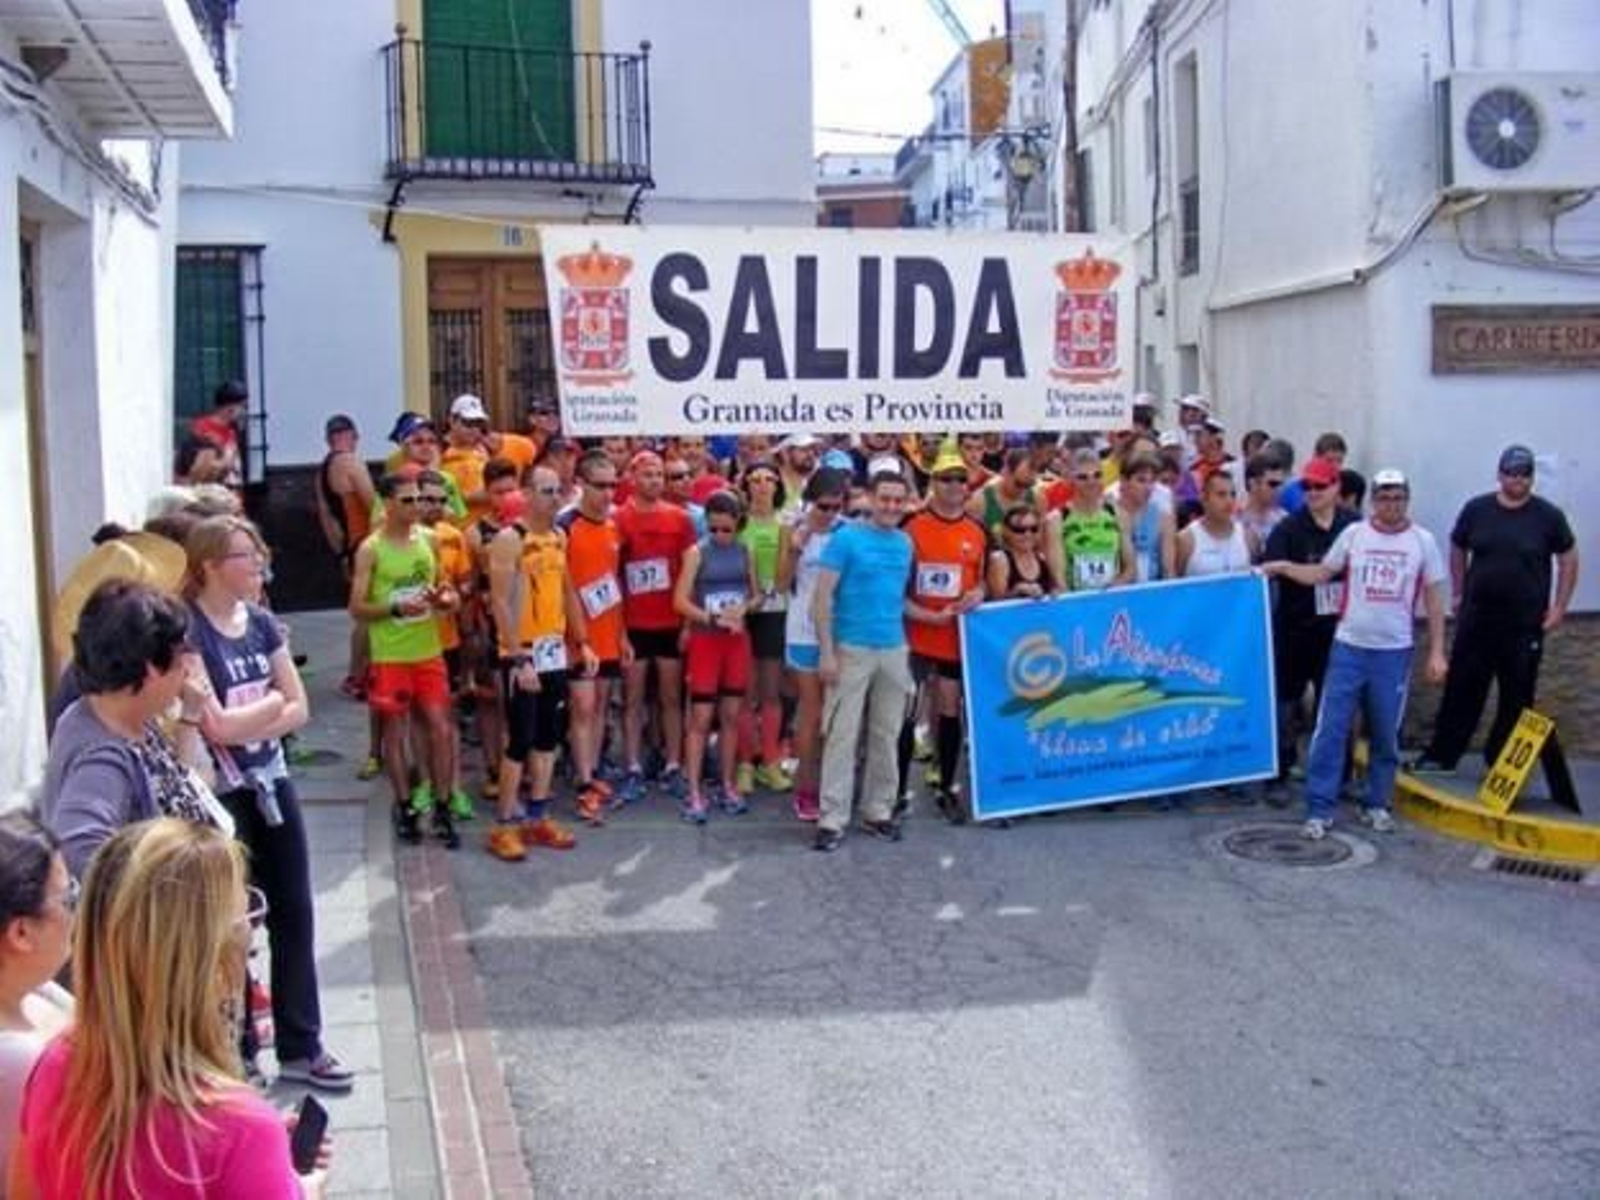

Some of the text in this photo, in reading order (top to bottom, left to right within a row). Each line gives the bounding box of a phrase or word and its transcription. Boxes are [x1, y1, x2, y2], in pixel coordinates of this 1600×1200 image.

[648, 252, 1026, 382] SALIDA
[573, 408, 637, 423] Granada
[683, 393, 1004, 423] Granada es Provincia
[1065, 404, 1125, 418] Granada
[1505, 737, 1533, 770] 10
[1486, 775, 1517, 800] KM
